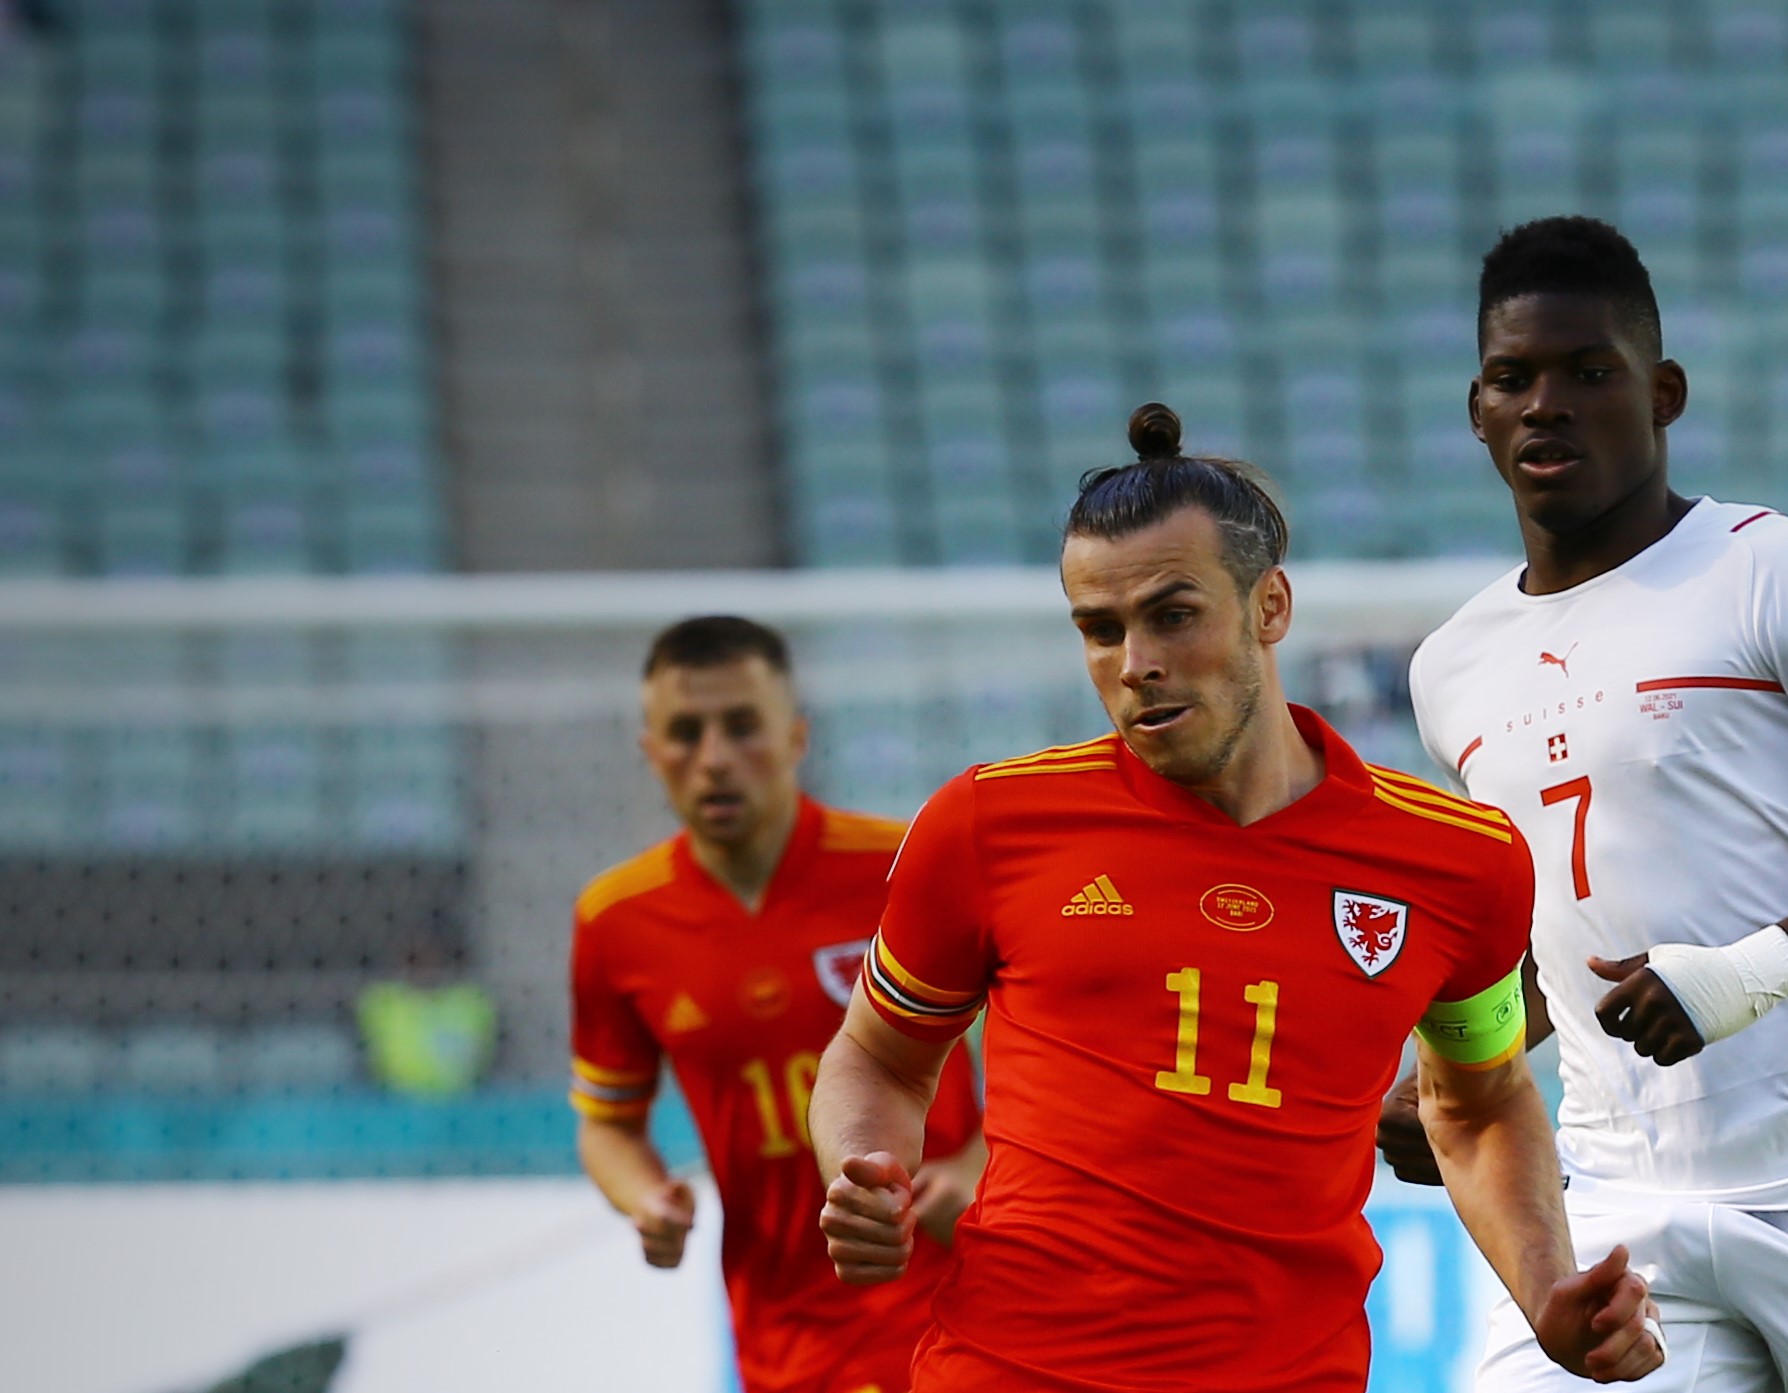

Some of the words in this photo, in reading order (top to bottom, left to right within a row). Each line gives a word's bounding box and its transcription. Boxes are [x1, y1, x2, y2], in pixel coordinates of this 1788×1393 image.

[1668, 700, 1683, 710] SUI
[1540, 775, 1593, 901] 7
[1061, 901, 1134, 916] adidas
[1154, 967, 1282, 1108] 11
